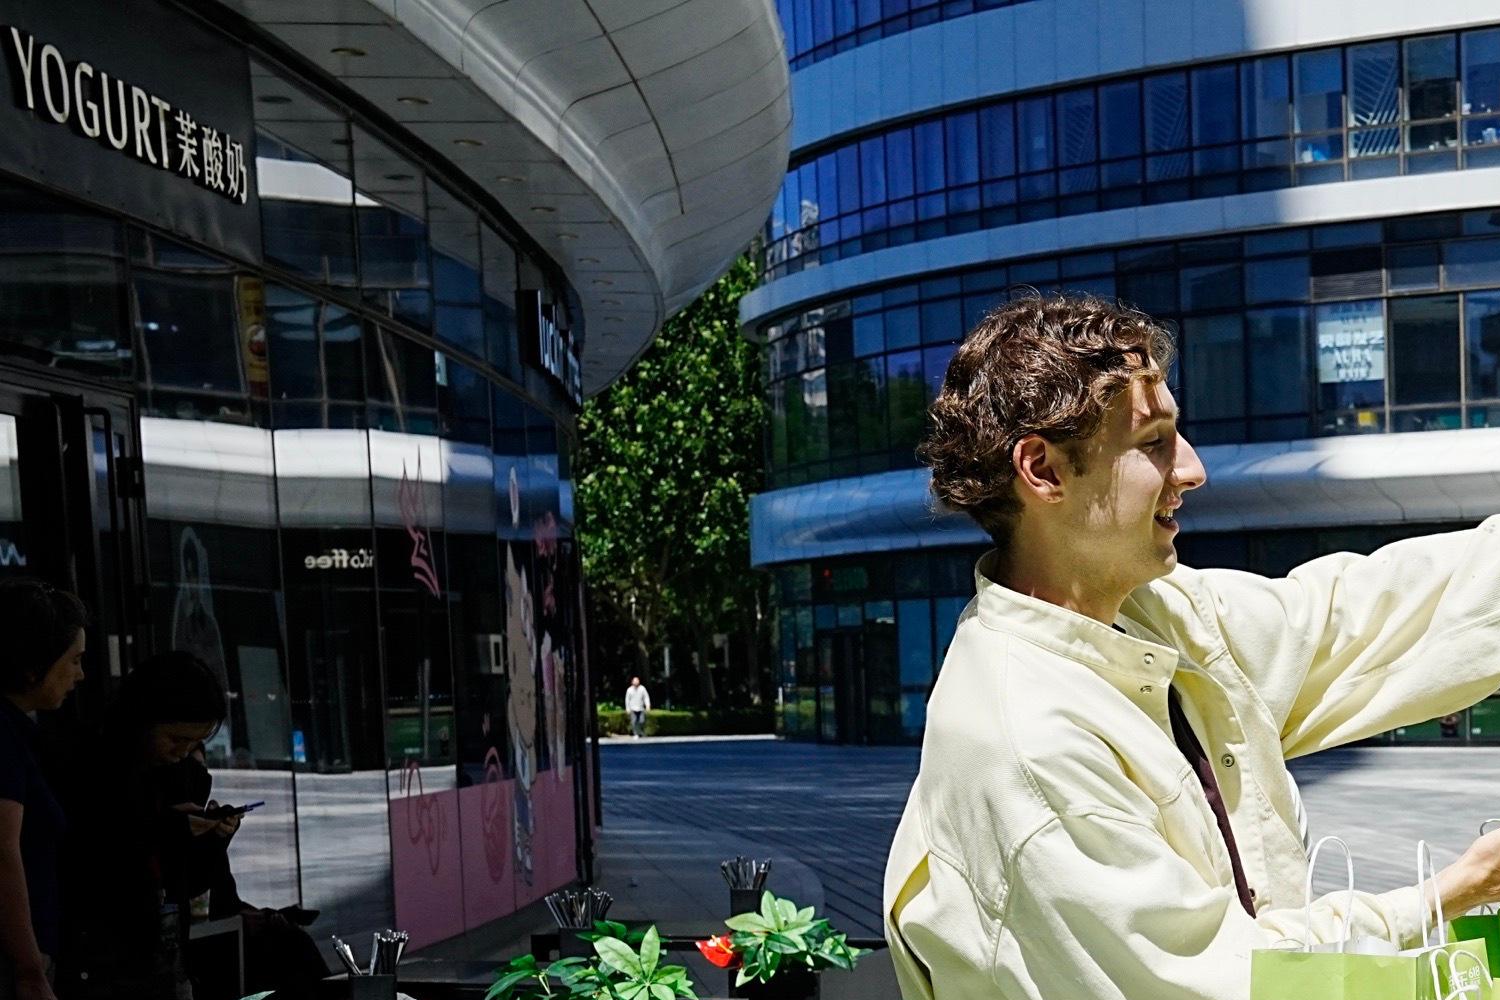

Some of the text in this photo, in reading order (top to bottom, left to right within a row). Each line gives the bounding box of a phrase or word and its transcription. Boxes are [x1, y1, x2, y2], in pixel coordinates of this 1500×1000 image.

[10, 26, 248, 205] YOGURT 茉酸奶
